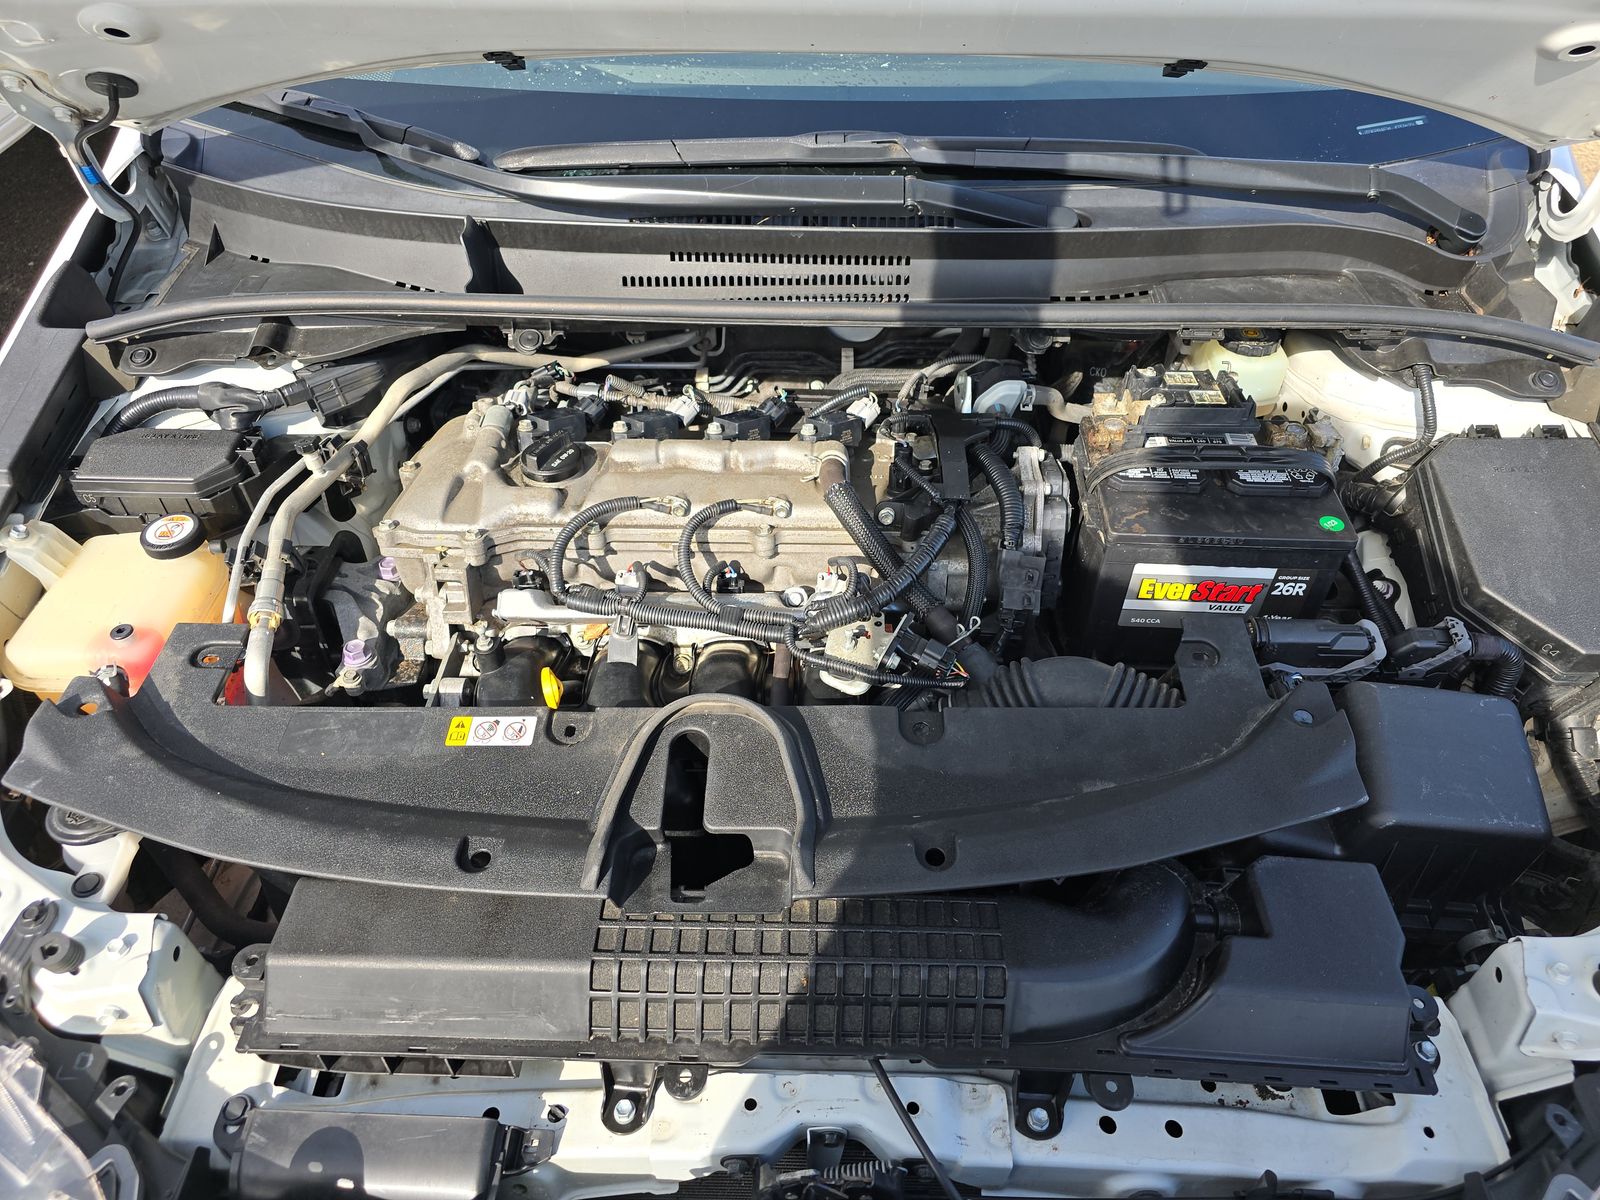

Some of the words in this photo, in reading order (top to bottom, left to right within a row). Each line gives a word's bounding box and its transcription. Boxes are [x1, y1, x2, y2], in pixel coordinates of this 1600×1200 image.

[1136, 577, 1265, 604] EverStart
[1270, 581, 1307, 596] 26R
[1208, 604, 1245, 612] VALUE
